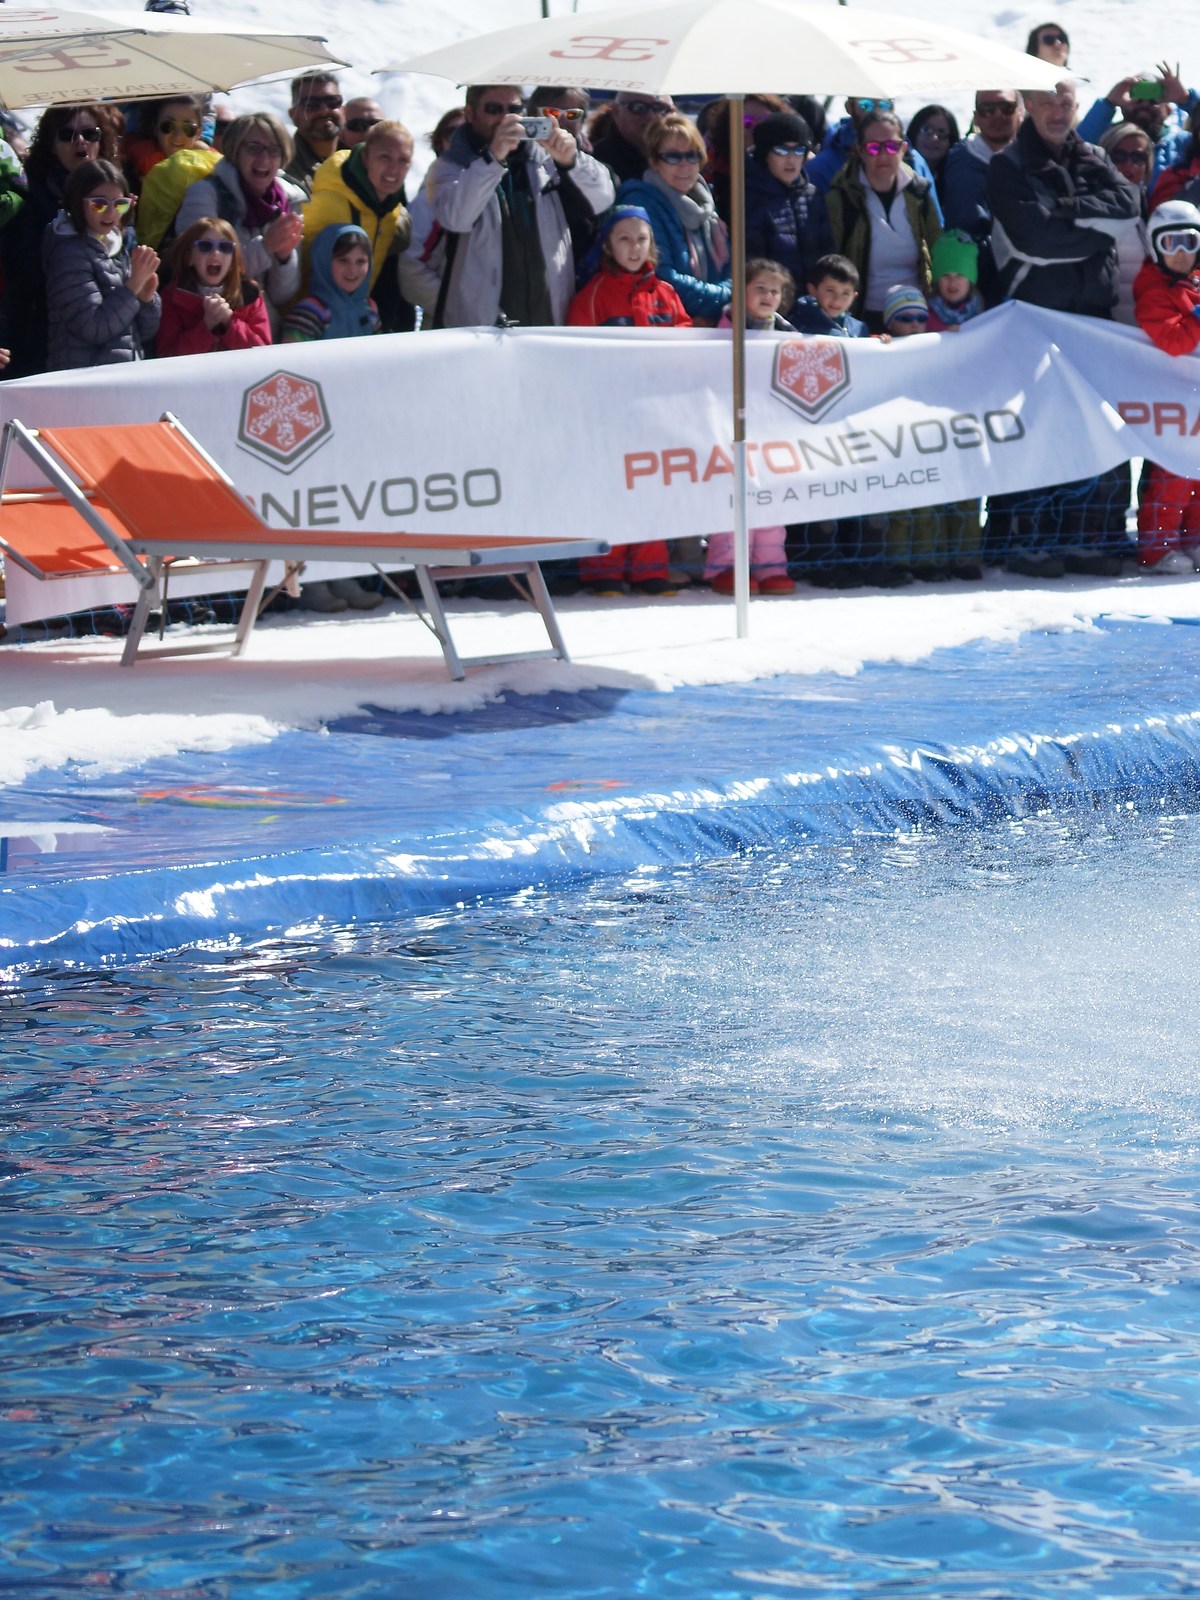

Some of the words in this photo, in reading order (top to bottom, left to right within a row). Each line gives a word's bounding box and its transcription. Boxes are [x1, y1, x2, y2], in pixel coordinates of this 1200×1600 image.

[623, 408, 1026, 490] PRATONEVOSO
[246, 467, 502, 528] NEVOSO
[782, 487, 799, 503] A
[807, 478, 858, 500] FUN
[866, 467, 942, 491] PLACE
